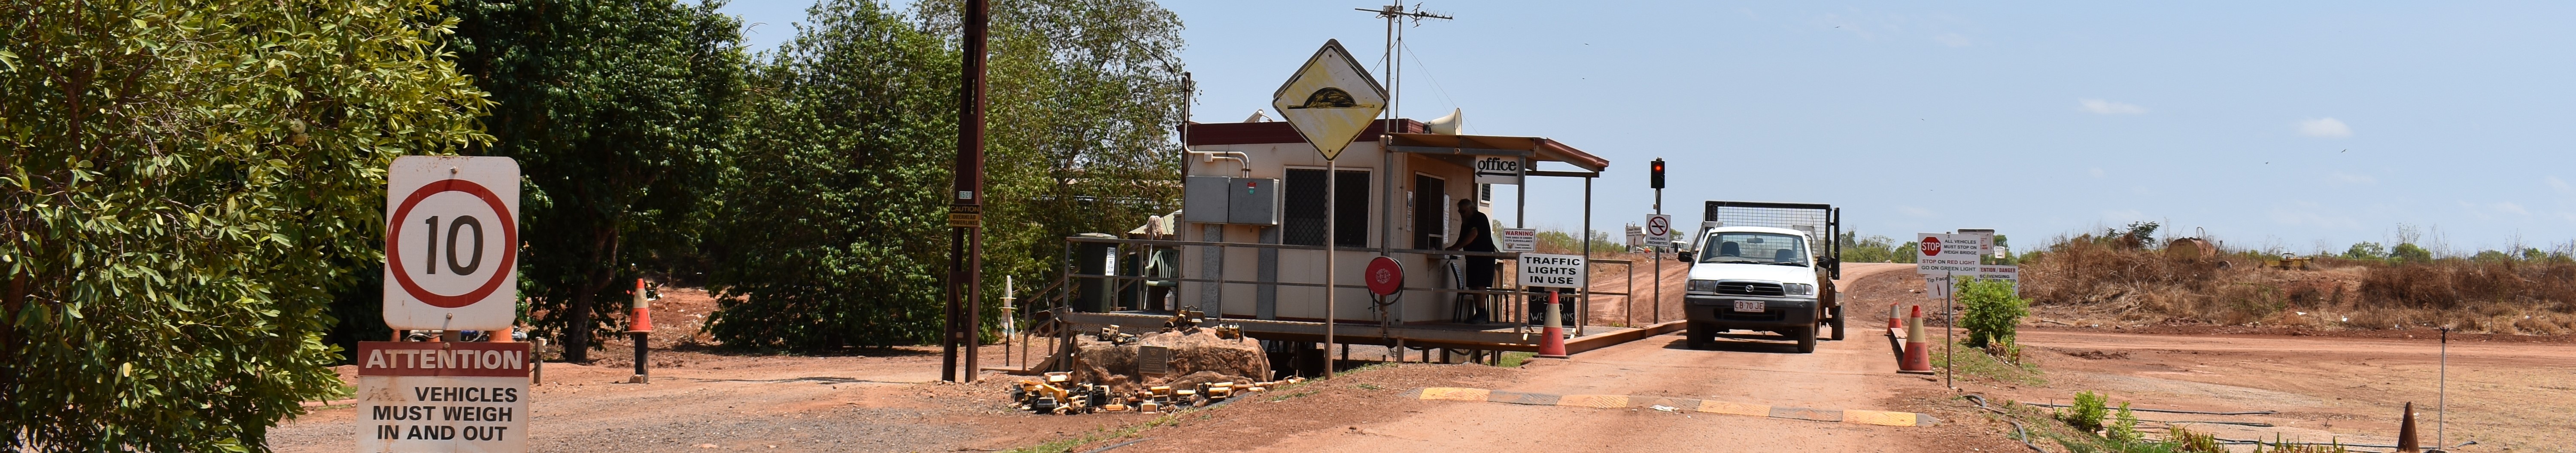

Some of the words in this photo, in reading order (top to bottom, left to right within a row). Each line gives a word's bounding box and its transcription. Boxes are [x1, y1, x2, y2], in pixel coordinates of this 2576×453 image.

[1477, 157, 1517, 171] office
[425, 215, 483, 275] 10
[1922, 242, 1940, 251] STOP
[1525, 257, 1580, 266] TRAFFIC
[1528, 266, 1576, 275] LIGHTS
[1548, 276, 1574, 285] USE
[366, 349, 522, 370] ATTENTION
[415, 387, 517, 402] VEHICLES
[373, 405, 436, 421] MUST
[443, 406, 513, 422] WEIGH
[377, 425, 399, 440] IN
[407, 425, 456, 441] AND
[463, 425, 507, 441] OUT
